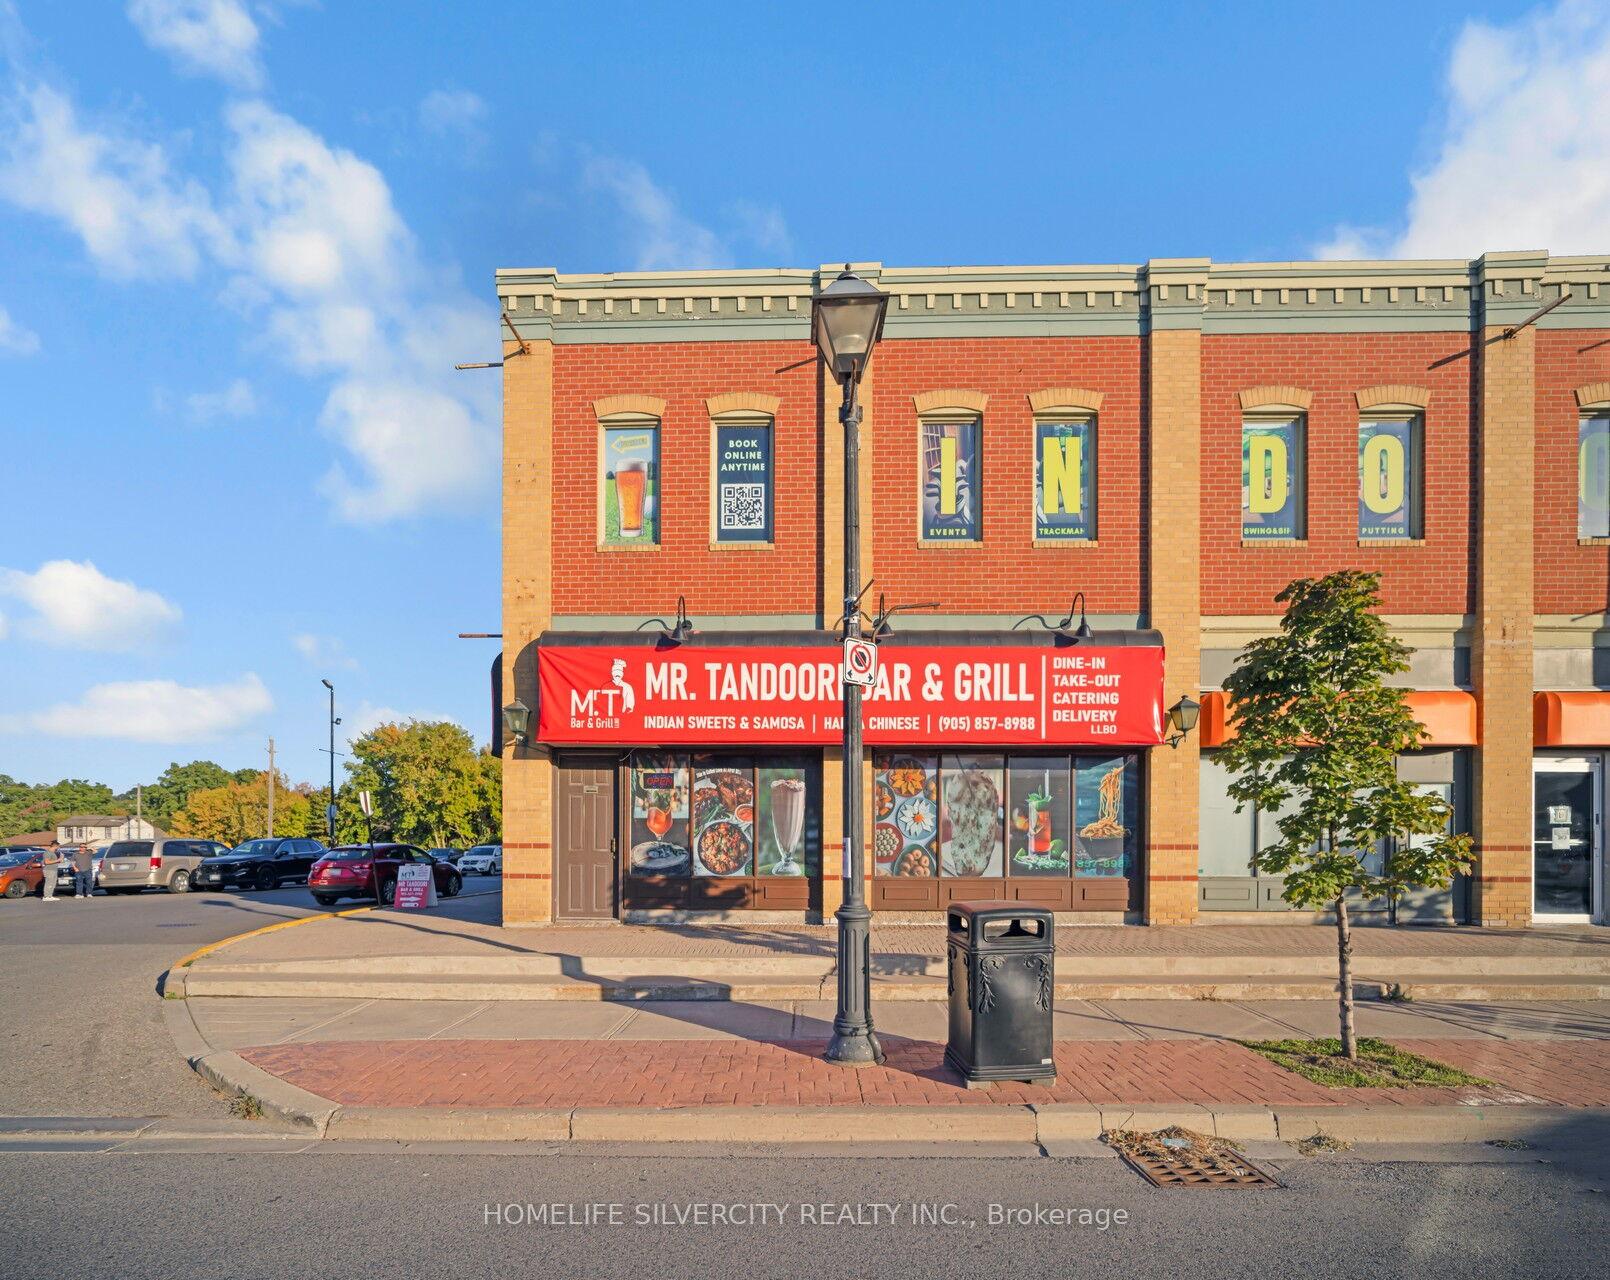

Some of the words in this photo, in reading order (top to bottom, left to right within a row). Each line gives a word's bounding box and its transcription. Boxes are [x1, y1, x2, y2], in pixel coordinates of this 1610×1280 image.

[728, 439, 758, 448] BOOK
[724, 451, 762, 460] ONLINE
[721, 463, 765, 471] ANYTIME
[1043, 436, 1082, 514] N
[1249, 435, 1288, 514] D
[930, 528, 967, 536] EVENTS
[1361, 526, 1405, 535] PUTTING
[1053, 656, 1106, 670] DINE-IN
[645, 662, 696, 701] MR.
[921, 662, 944, 701] &
[954, 662, 1035, 701] GRILL
[1052, 674, 1121, 687] TAKE-OUT
[1052, 691, 1120, 705] CATERING
[1052, 709, 1117, 722] DELIVERY
[570, 717, 585, 729] Bar
[587, 717, 594, 729] &
[595, 717, 614, 729] Grill
[644, 716, 685, 730] INDIAN
[688, 716, 736, 730] SWEETS
[740, 716, 750, 730] &
[753, 716, 805, 730] SAMOSA
[868, 716, 920, 730] CHINESE
[938, 715, 971, 732] (905)
[974, 716, 1035, 731] 857-8988
[1091, 724, 1117, 734] LLBO
